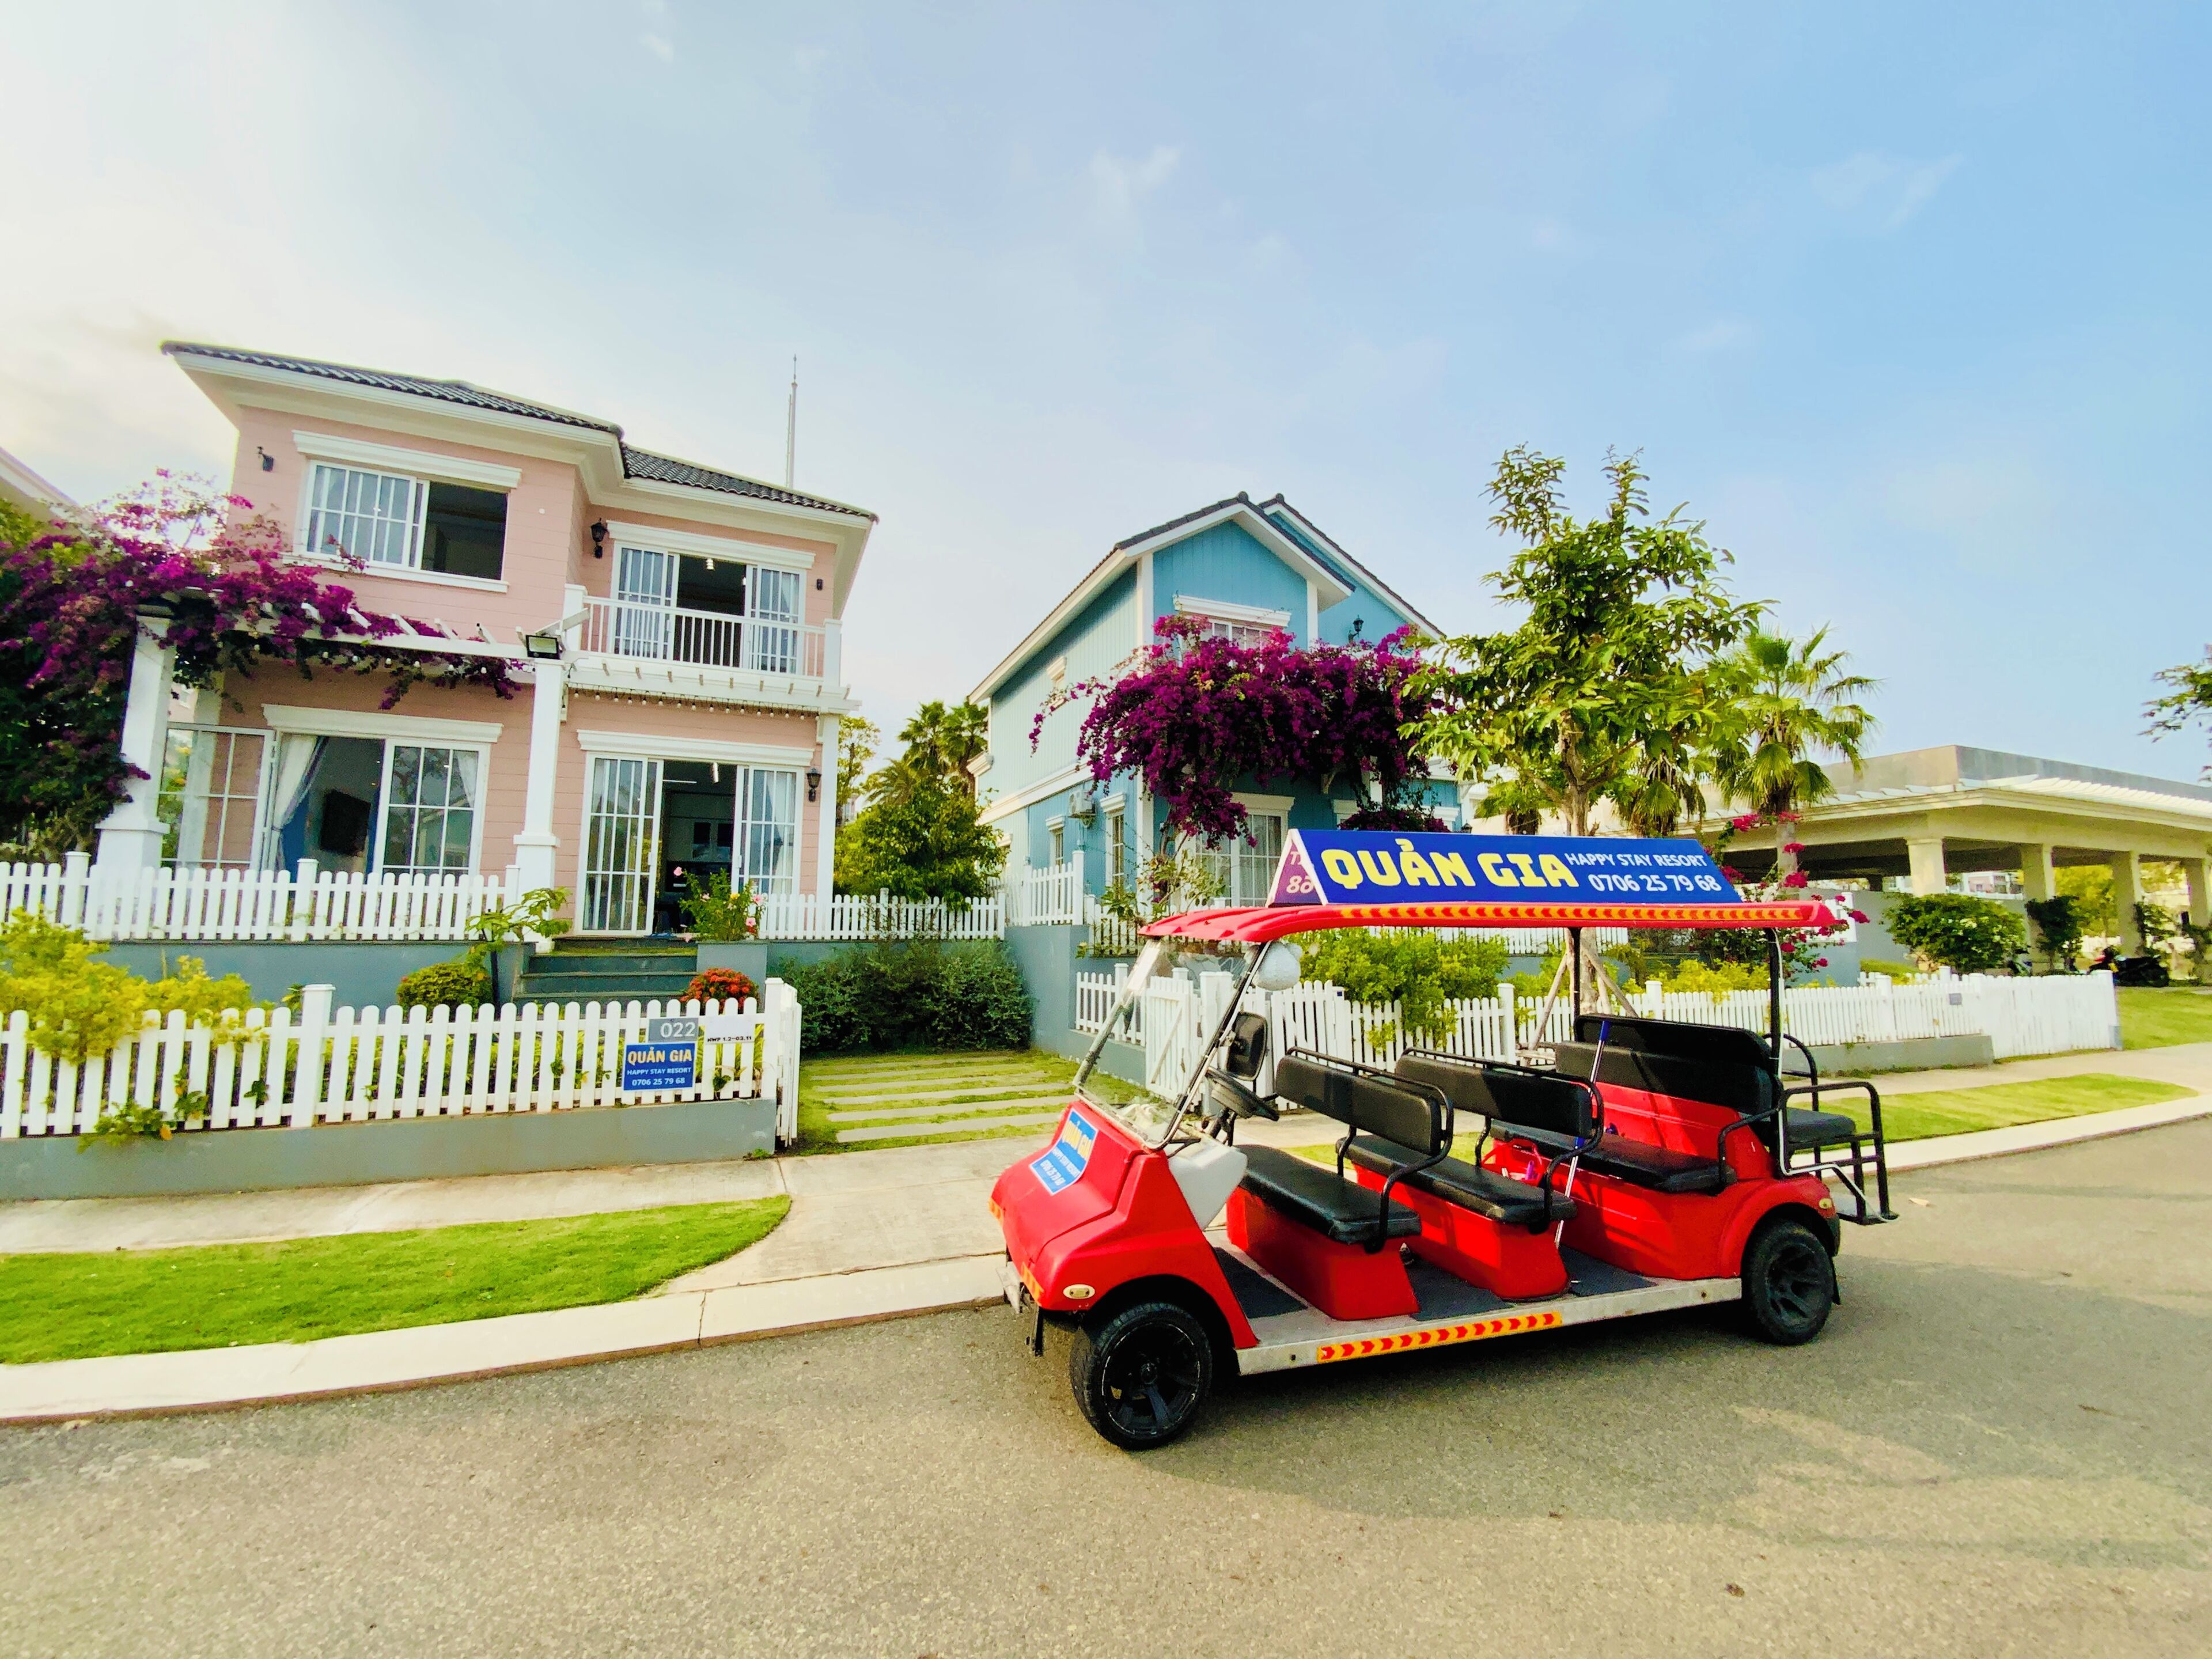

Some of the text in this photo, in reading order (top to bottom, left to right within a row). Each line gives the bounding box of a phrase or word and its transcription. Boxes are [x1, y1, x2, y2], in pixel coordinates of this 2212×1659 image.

[1321, 838, 1579, 889] QUẢN GIA
[1564, 853, 1707, 867] HAPPY STAY RESORT
[1588, 874, 1722, 892] 0706 25 79 68
[660, 1022, 695, 1037] 022
[627, 1046, 692, 1066] QUẢN GIA
